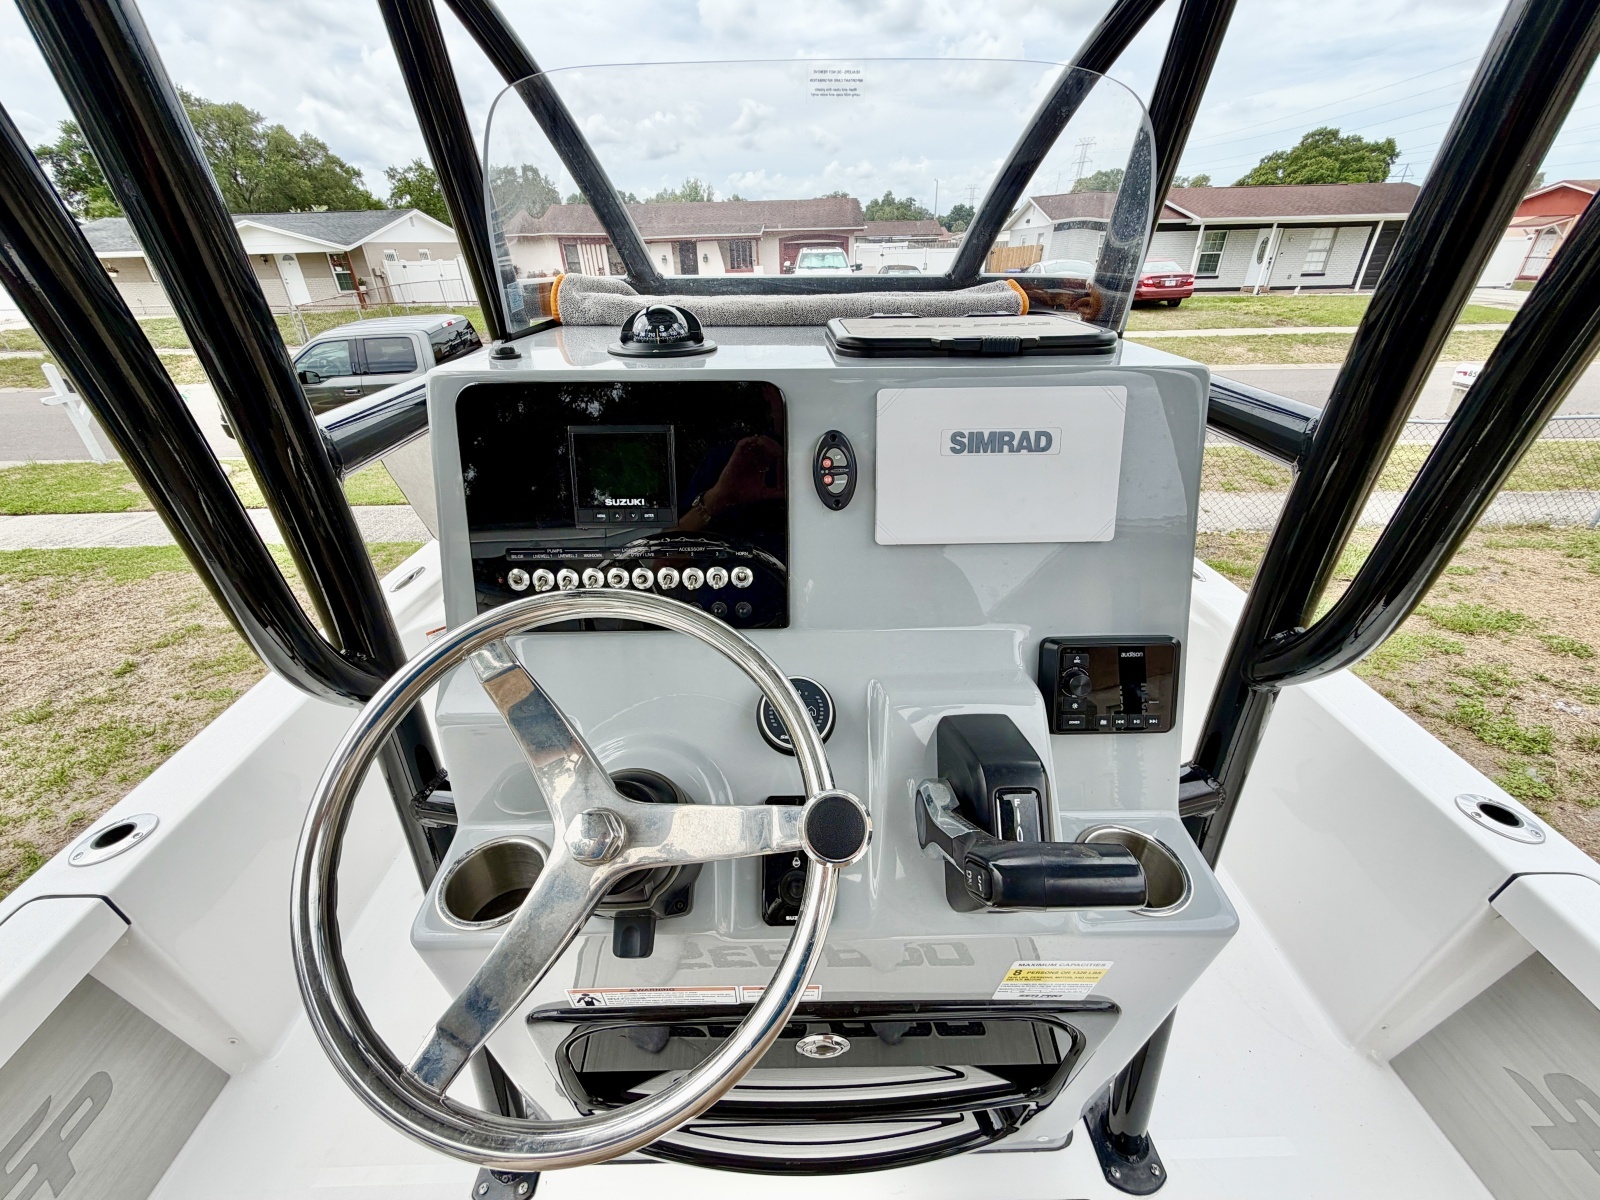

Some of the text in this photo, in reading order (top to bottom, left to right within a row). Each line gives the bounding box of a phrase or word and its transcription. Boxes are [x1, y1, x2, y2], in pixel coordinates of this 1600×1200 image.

[949, 430, 1053, 454] SIMRAD
[605, 498, 645, 506] SUZUKI
[1014, 798, 1020, 807] F
